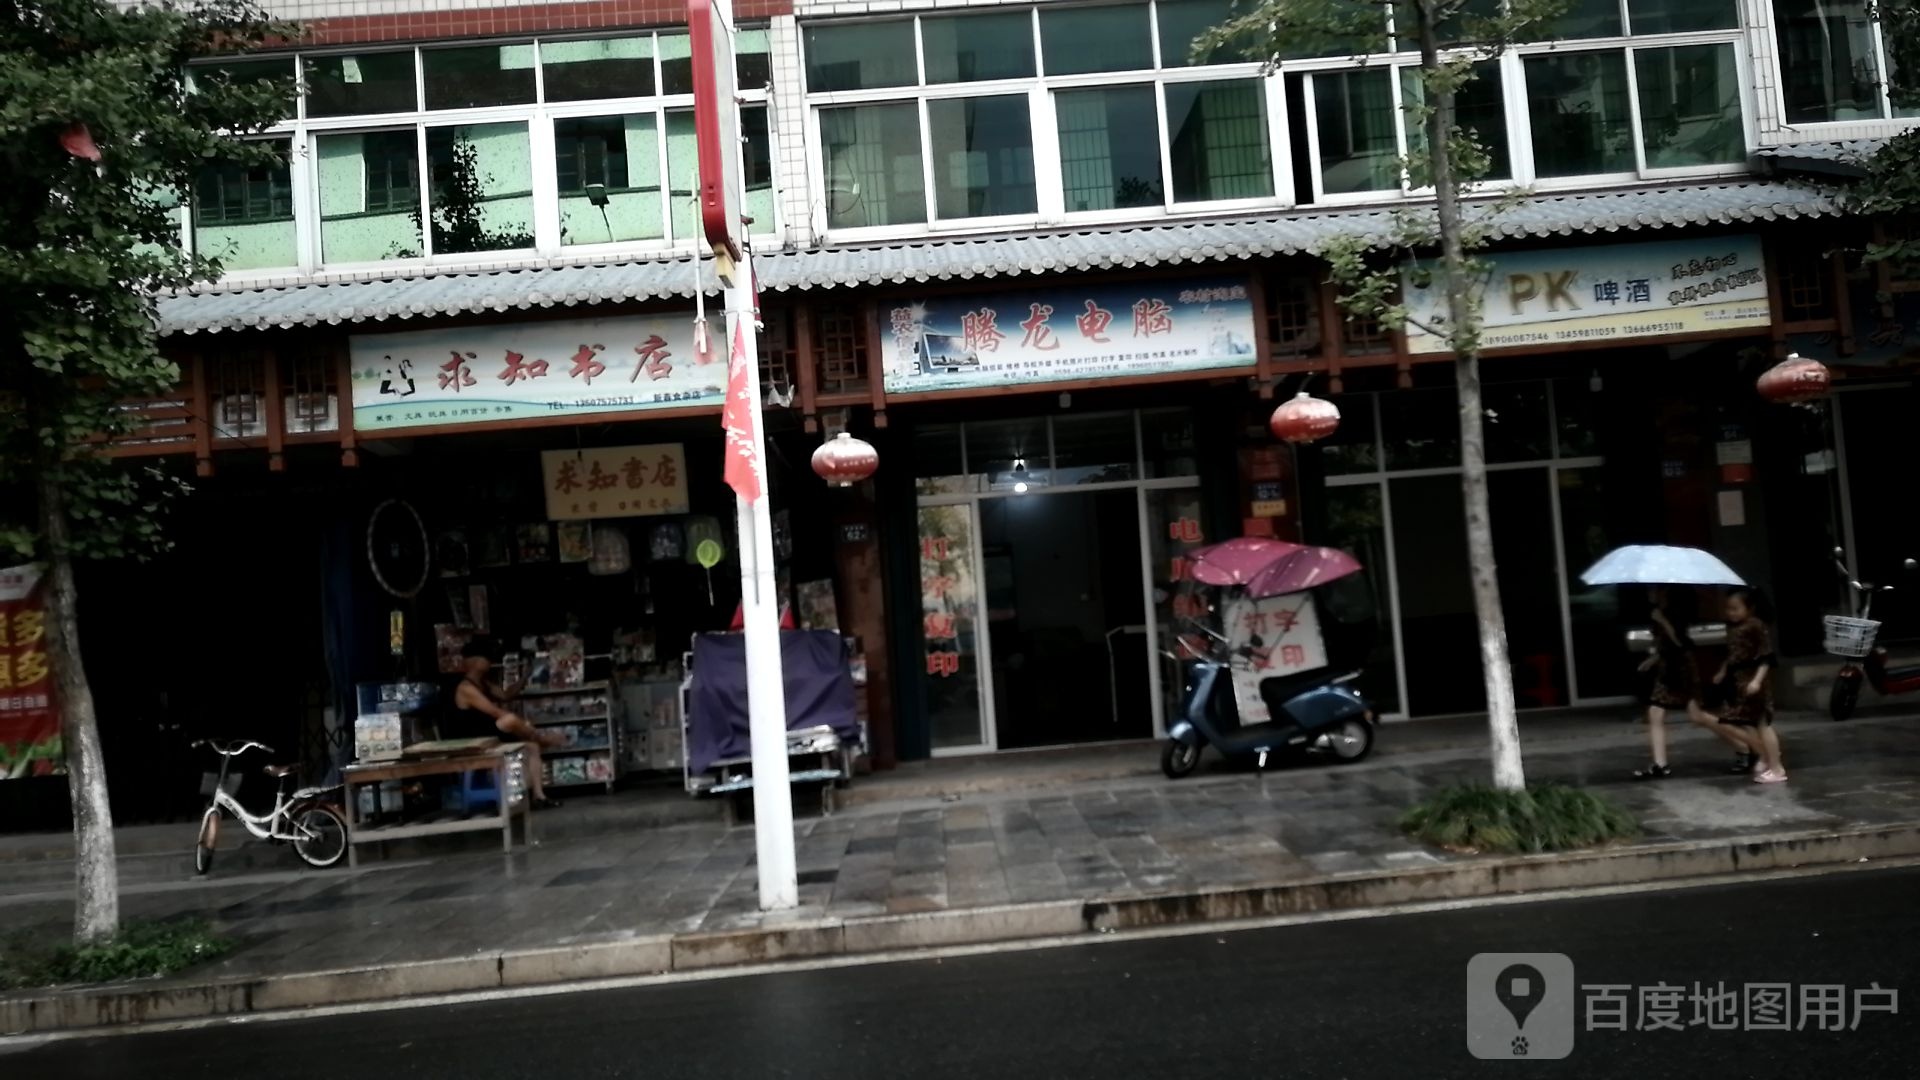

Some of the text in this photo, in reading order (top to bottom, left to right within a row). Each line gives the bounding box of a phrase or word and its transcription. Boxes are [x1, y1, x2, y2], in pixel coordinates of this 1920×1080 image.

[1508, 270, 1582, 315] PK
[1593, 279, 1651, 305] 啤酒
[961, 300, 1174, 353] 腾龙电脑
[437, 335, 673, 393] 求知书店
[555, 454, 676, 494] 求知書店
[0, 609, 45, 646] 多
[923, 536, 960, 677] 打字复印
[1244, 609, 1299, 635] 打字
